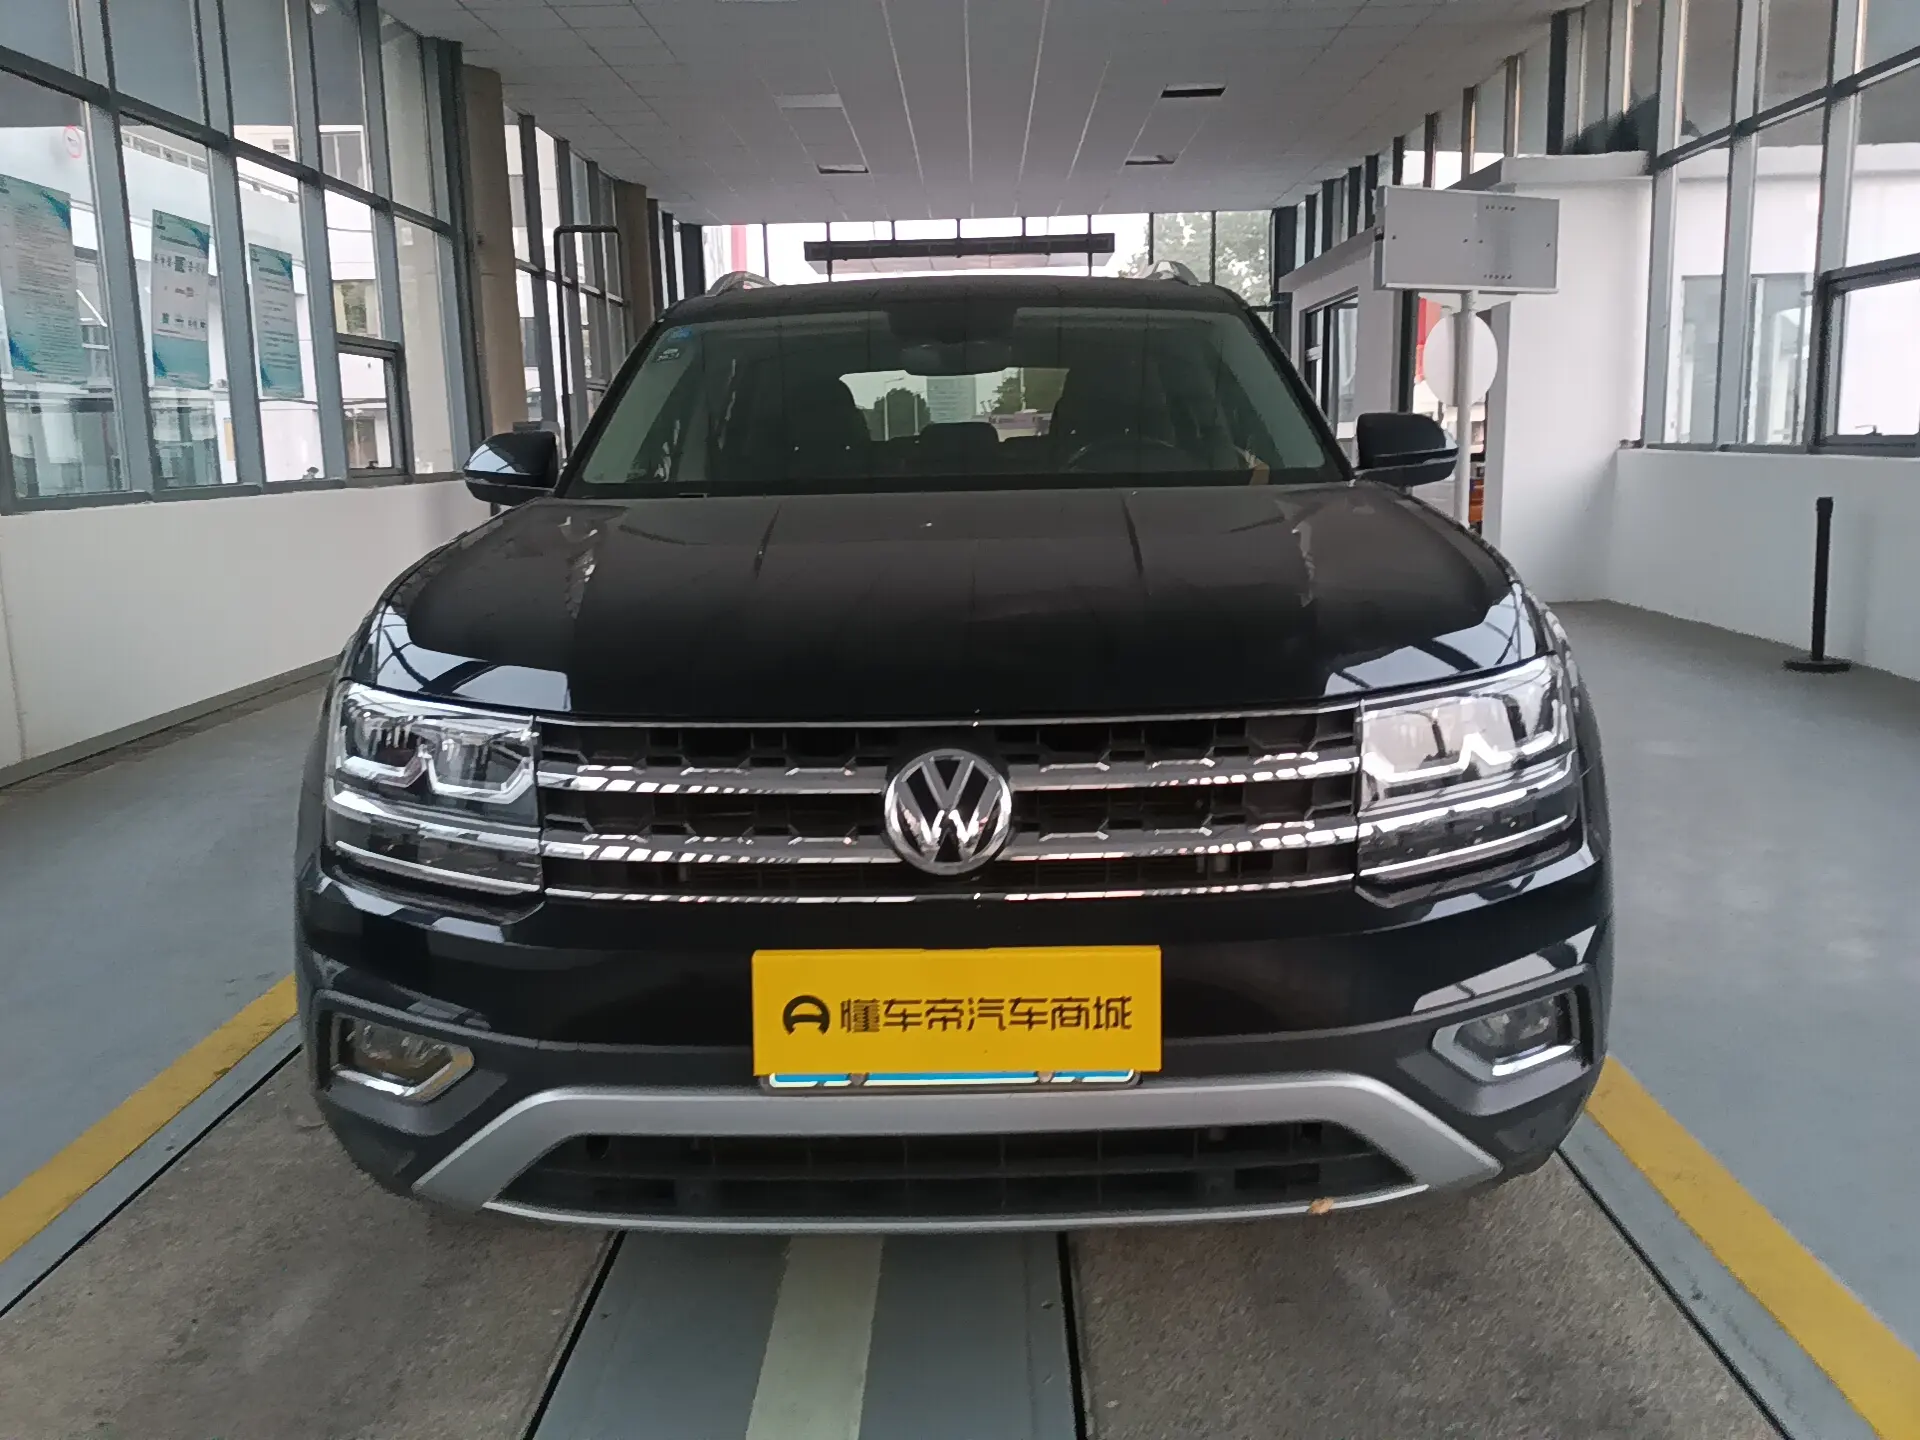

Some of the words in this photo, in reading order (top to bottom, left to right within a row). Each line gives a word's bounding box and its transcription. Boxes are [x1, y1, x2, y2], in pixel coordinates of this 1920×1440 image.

[840, 996, 1132, 1032] 懂车帝汽车商城
